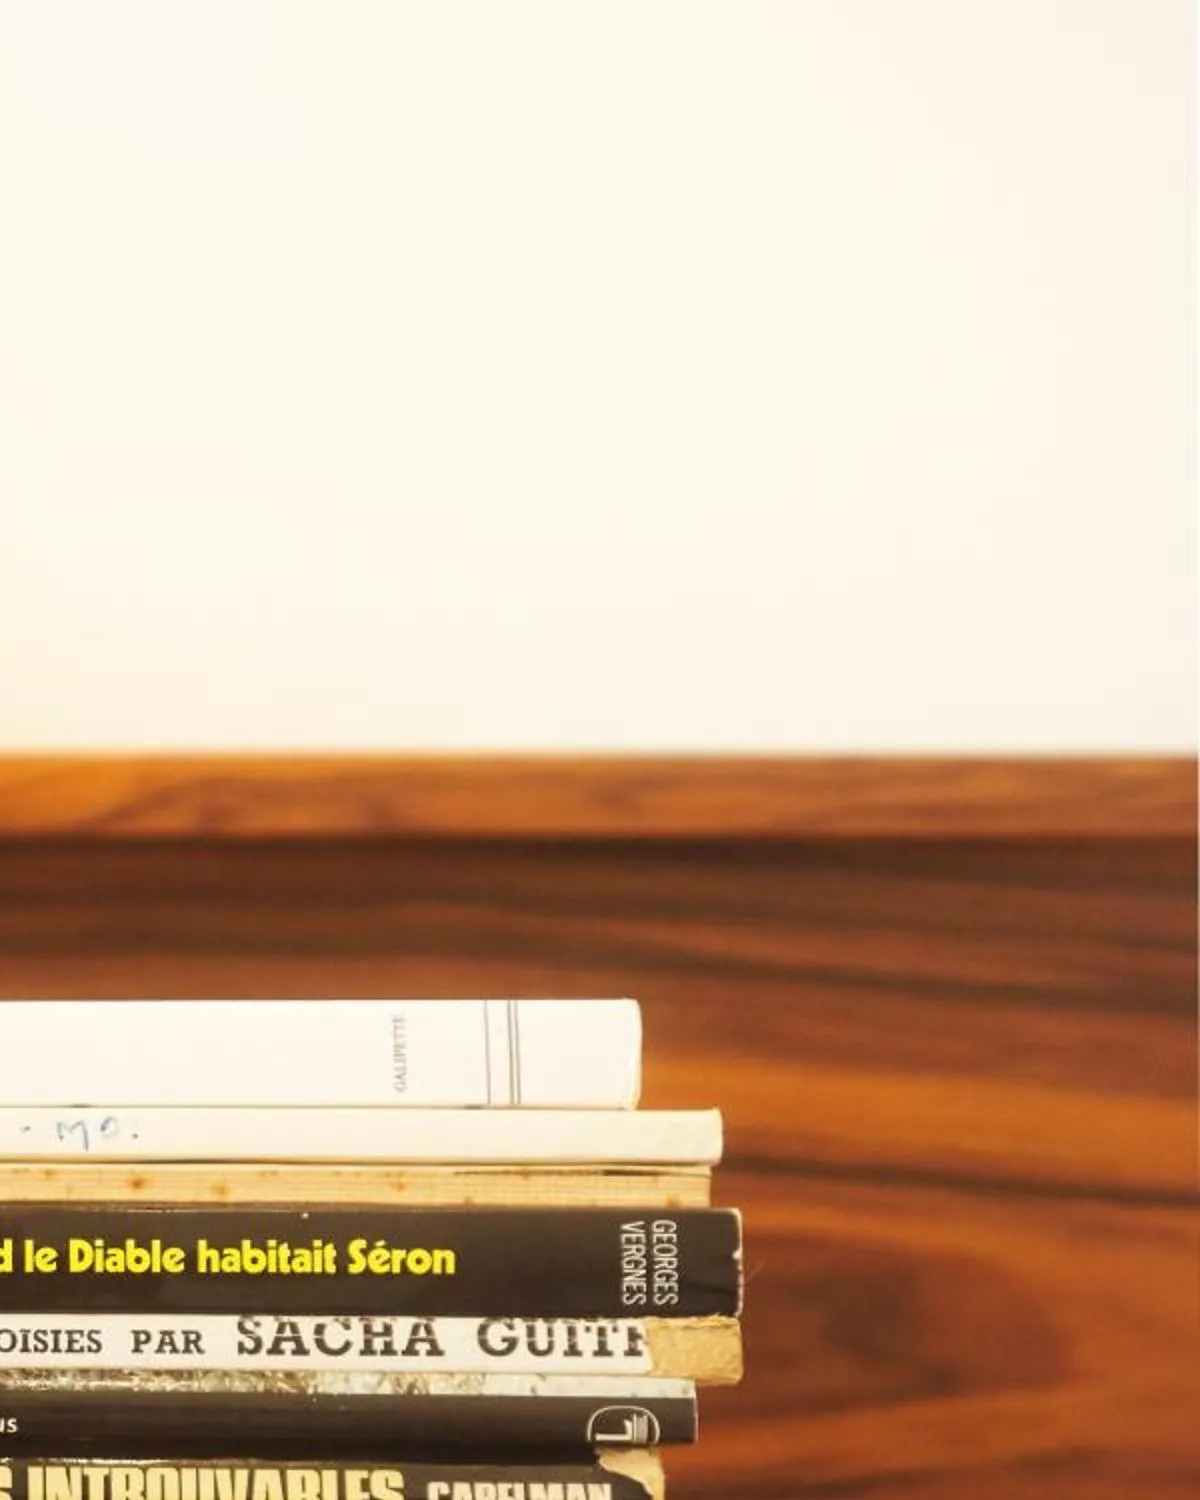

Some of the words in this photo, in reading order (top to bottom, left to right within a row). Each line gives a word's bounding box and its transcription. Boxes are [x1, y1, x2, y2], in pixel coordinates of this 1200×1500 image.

[25, 1239, 57, 1273] le
[69, 1239, 186, 1273] Diable
[197, 1239, 337, 1274] habitait
[347, 1239, 456, 1275] Séron
[620, 1220, 648, 1306] VERGNES
[652, 1218, 679, 1306] GEORGES
[130, 1329, 205, 1354] PAR
[237, 1315, 445, 1357] SACHA
